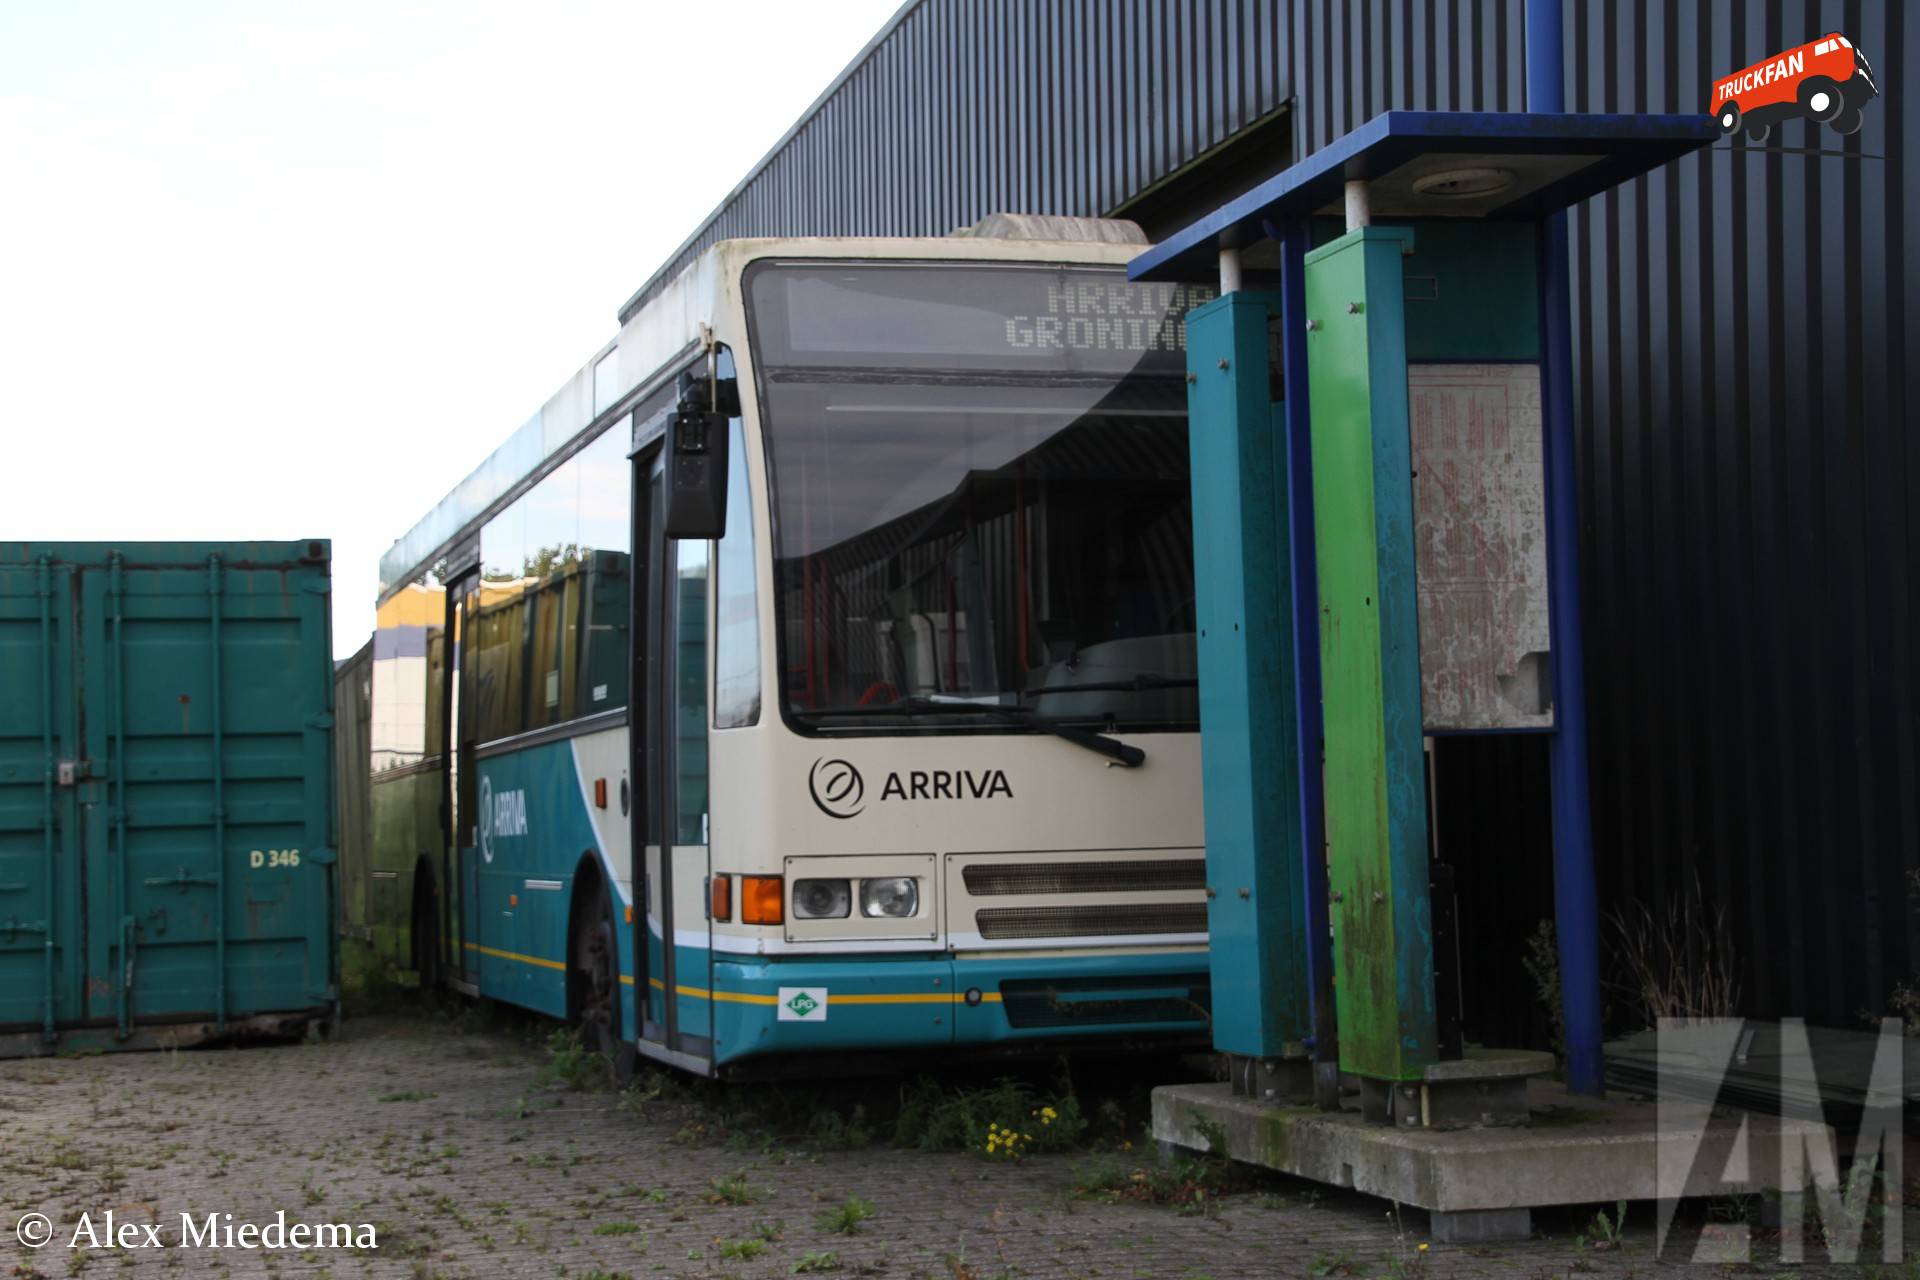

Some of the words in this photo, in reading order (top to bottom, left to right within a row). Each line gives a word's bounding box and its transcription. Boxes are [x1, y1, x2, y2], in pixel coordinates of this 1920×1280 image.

[880, 769, 1014, 801] ARRIVA
[494, 789, 528, 836] ARRIVA
[250, 850, 265, 869] D
[268, 849, 300, 868] 346
